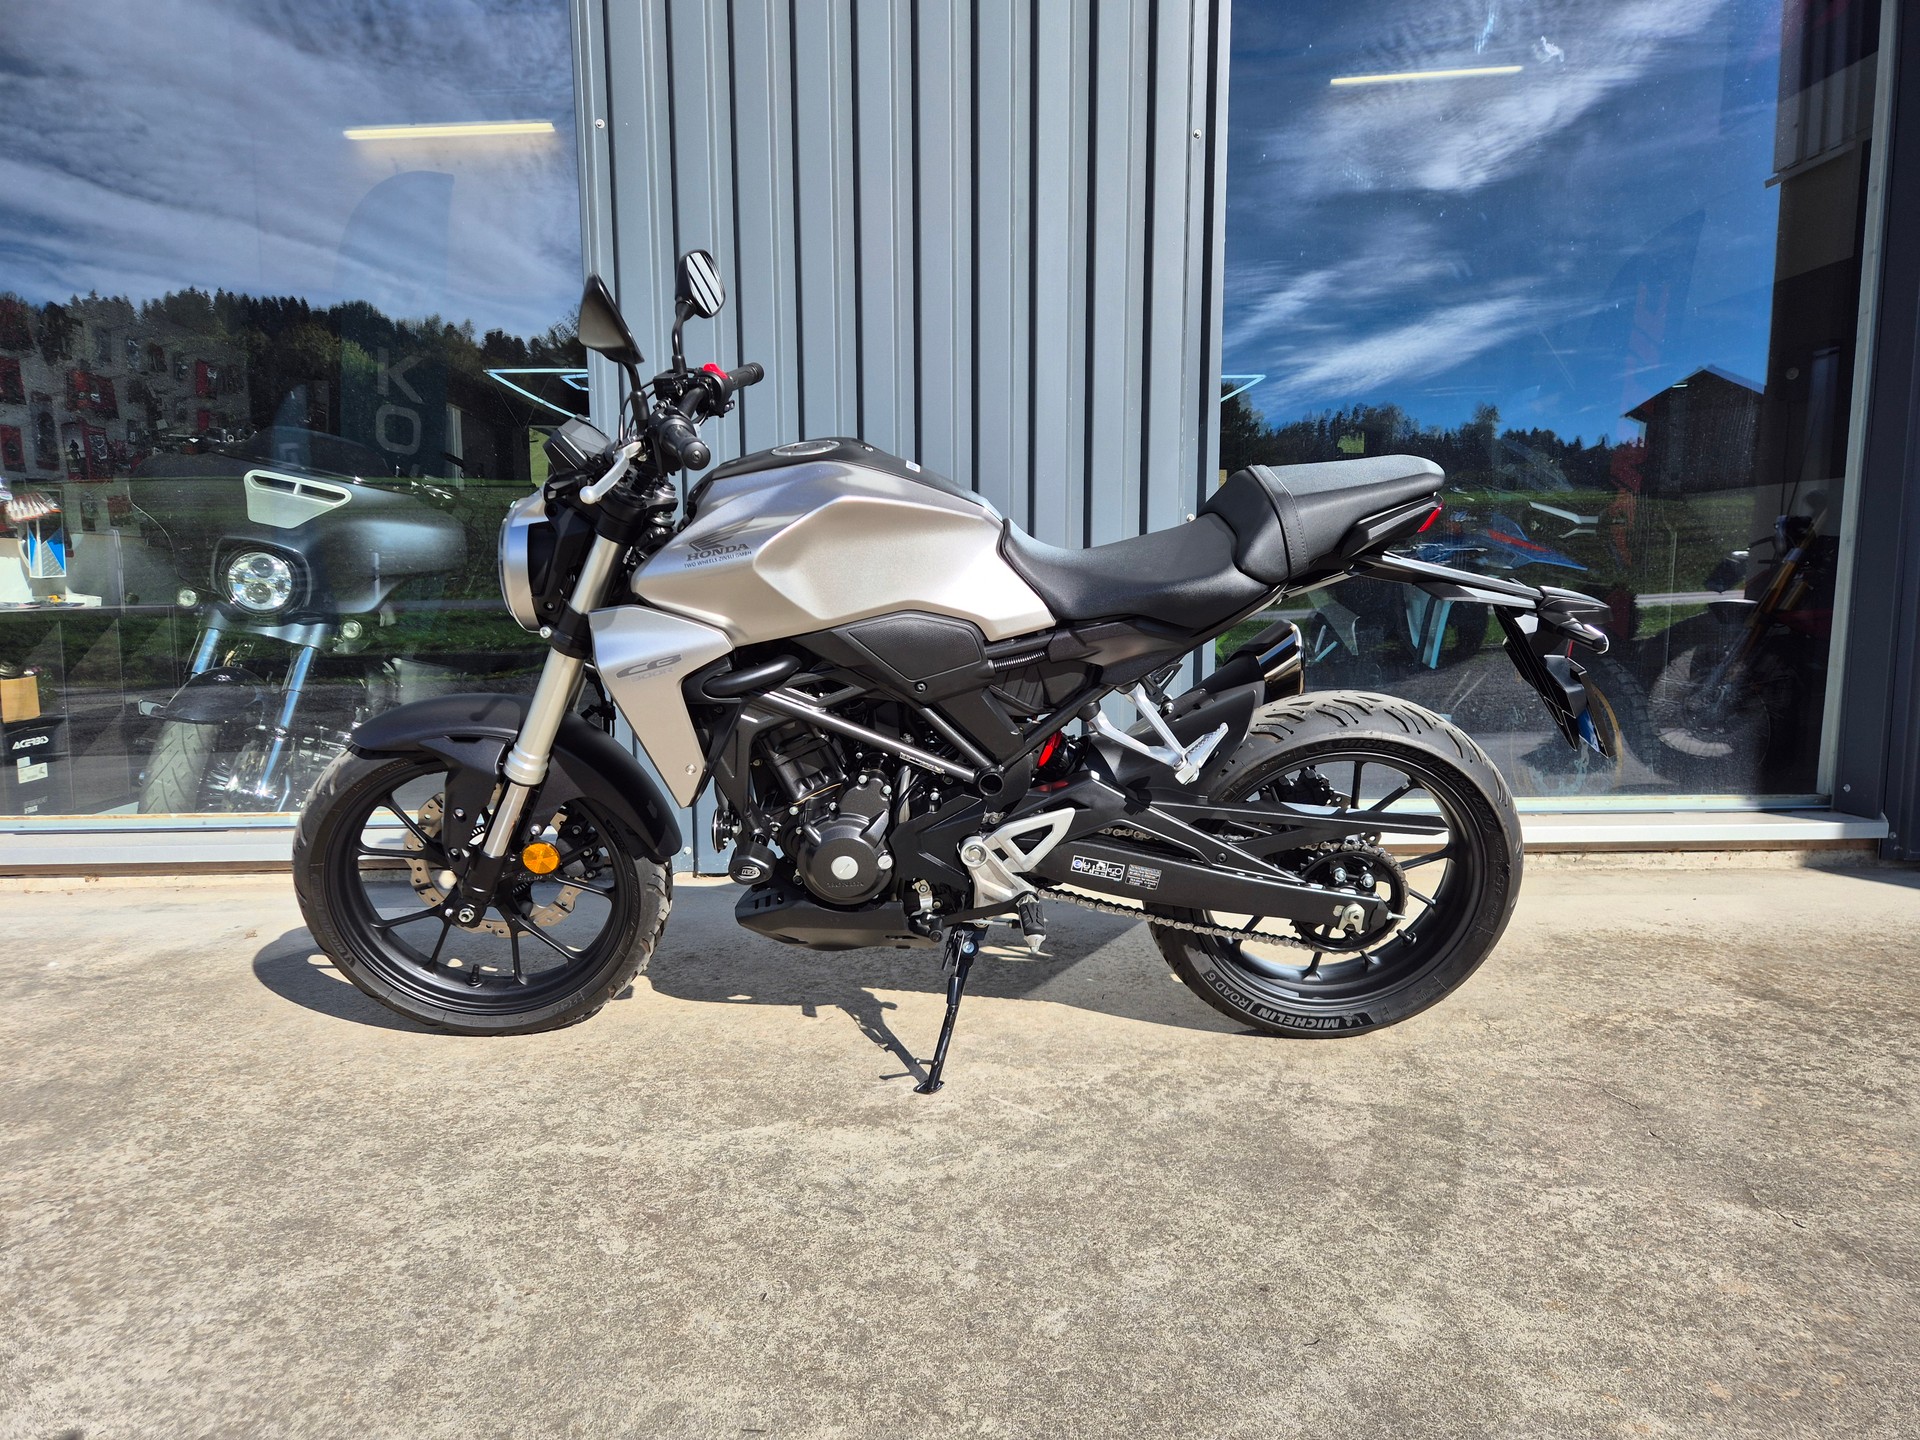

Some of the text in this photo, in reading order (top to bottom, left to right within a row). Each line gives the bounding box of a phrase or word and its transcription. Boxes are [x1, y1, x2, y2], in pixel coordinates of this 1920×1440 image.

[686, 543, 749, 561] HONDA
[12, 735, 50, 750] ACERBIS
[1205, 971, 1341, 1030] MICHELIN ROAD 6
